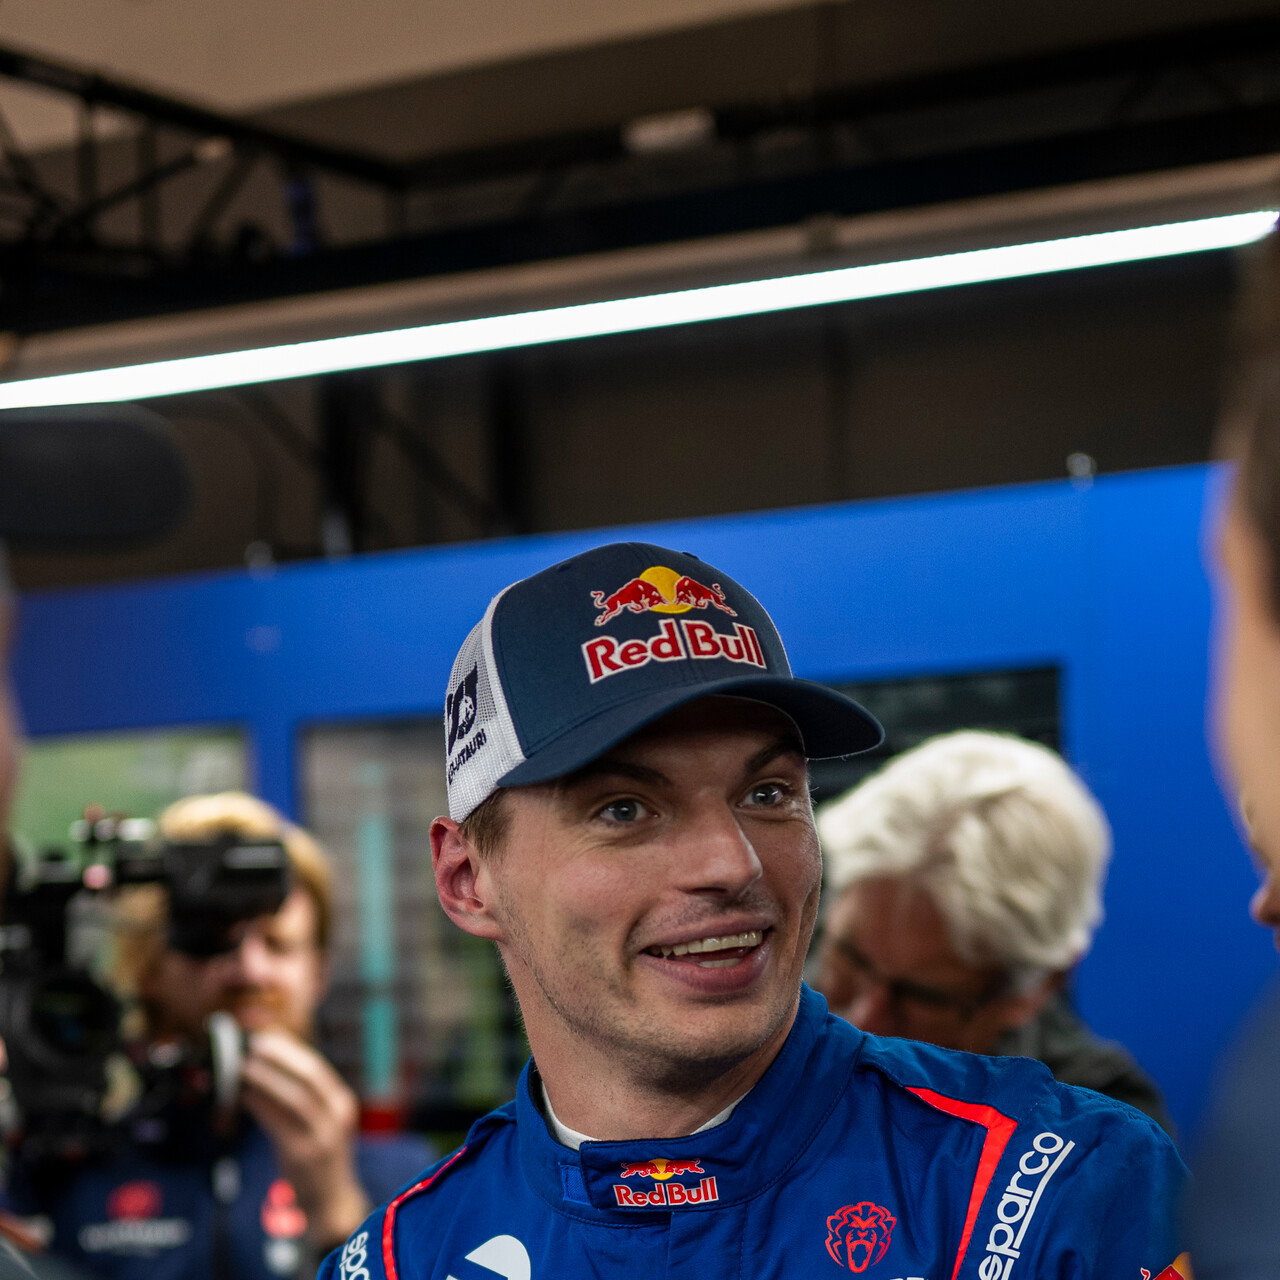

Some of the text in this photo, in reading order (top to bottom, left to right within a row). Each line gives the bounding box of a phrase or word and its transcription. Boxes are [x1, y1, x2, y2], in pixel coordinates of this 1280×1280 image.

[581, 618, 768, 684] Red Bull
[613, 1176, 720, 1206] Red Bull
